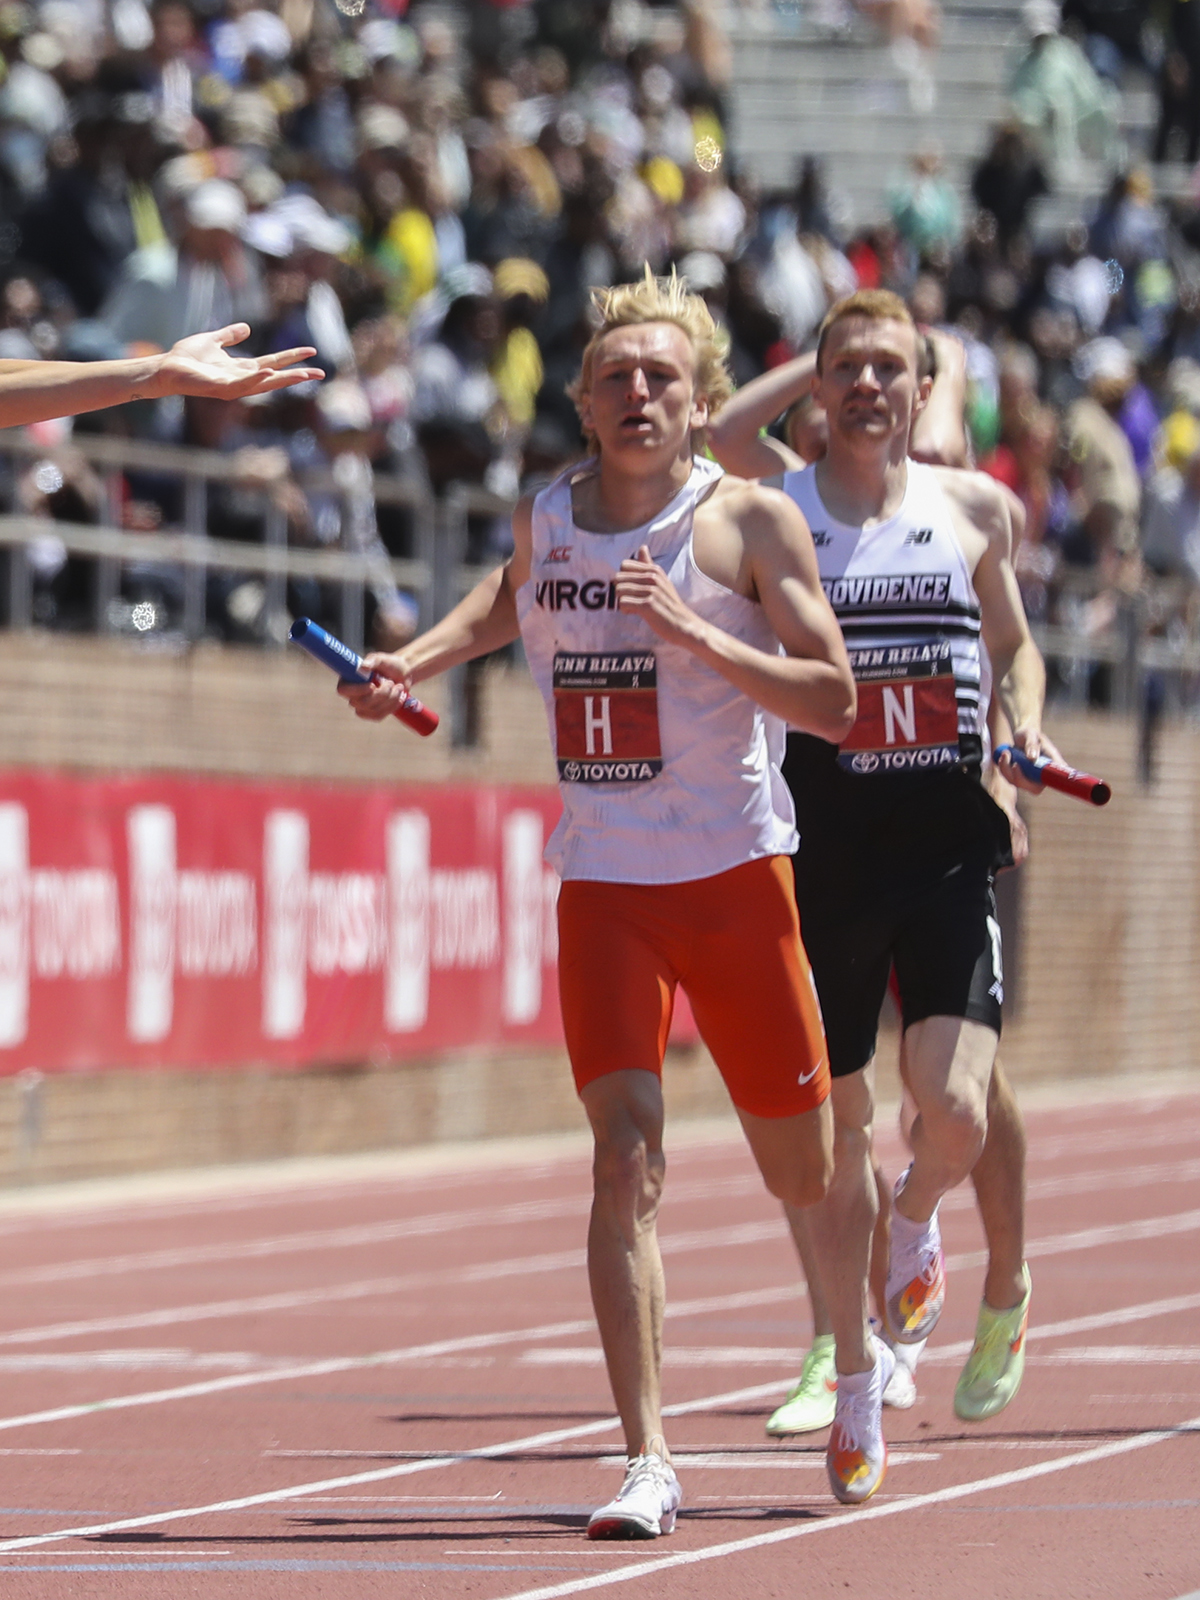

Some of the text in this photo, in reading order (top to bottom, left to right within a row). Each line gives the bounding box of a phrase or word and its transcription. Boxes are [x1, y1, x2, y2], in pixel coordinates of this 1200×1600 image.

[535, 579, 621, 612] VIRGI
[821, 574, 950, 604] ROVIDENCE
[588, 656, 655, 673] RELAYS
[849, 641, 951, 667] ENN RELAYS
[584, 696, 613, 755] H
[882, 684, 917, 745] N
[581, 762, 654, 780] TOYOTA
[880, 747, 952, 769] TOYOTA
